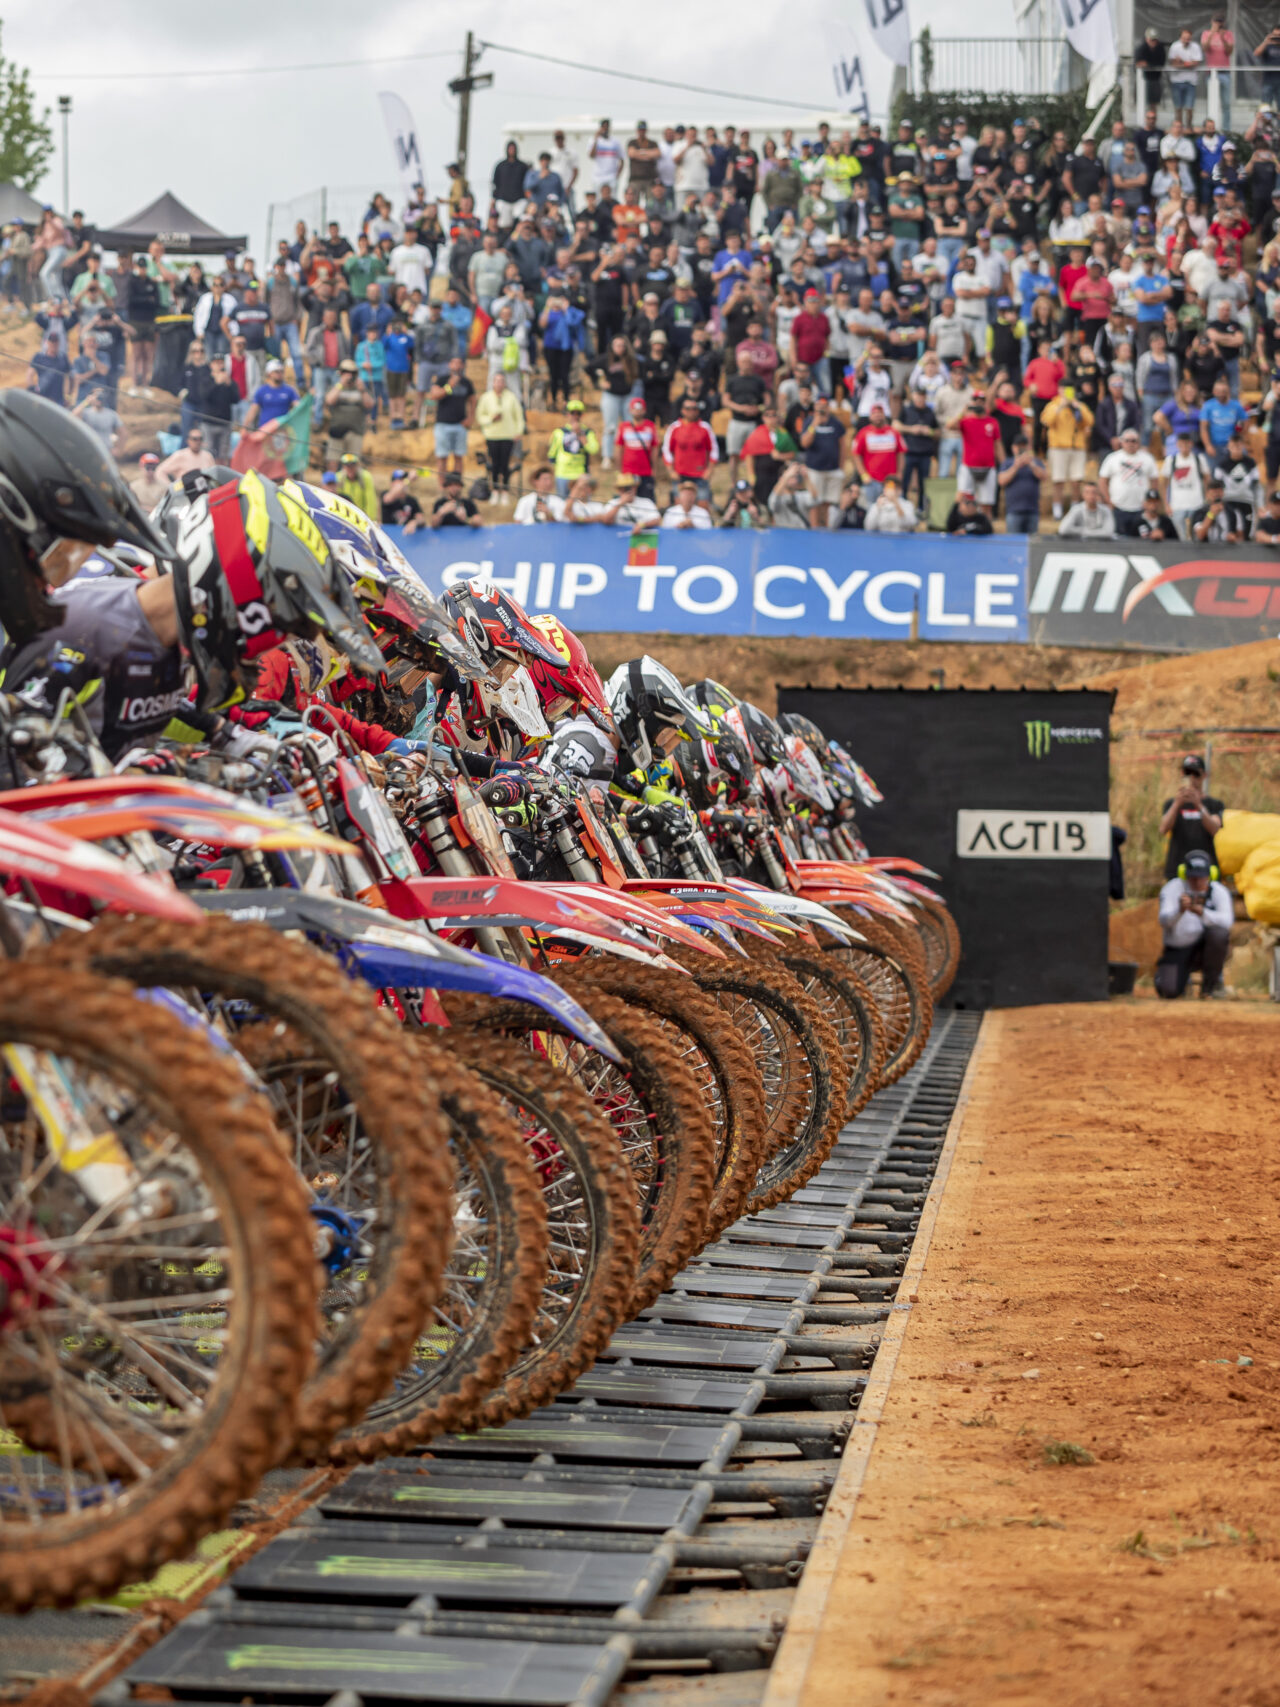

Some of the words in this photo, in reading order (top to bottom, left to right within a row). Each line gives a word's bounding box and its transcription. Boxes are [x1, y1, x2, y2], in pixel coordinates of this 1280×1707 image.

[623, 564, 739, 615] TO
[753, 564, 1019, 628] CYCLE
[1029, 552, 1280, 624] MXG
